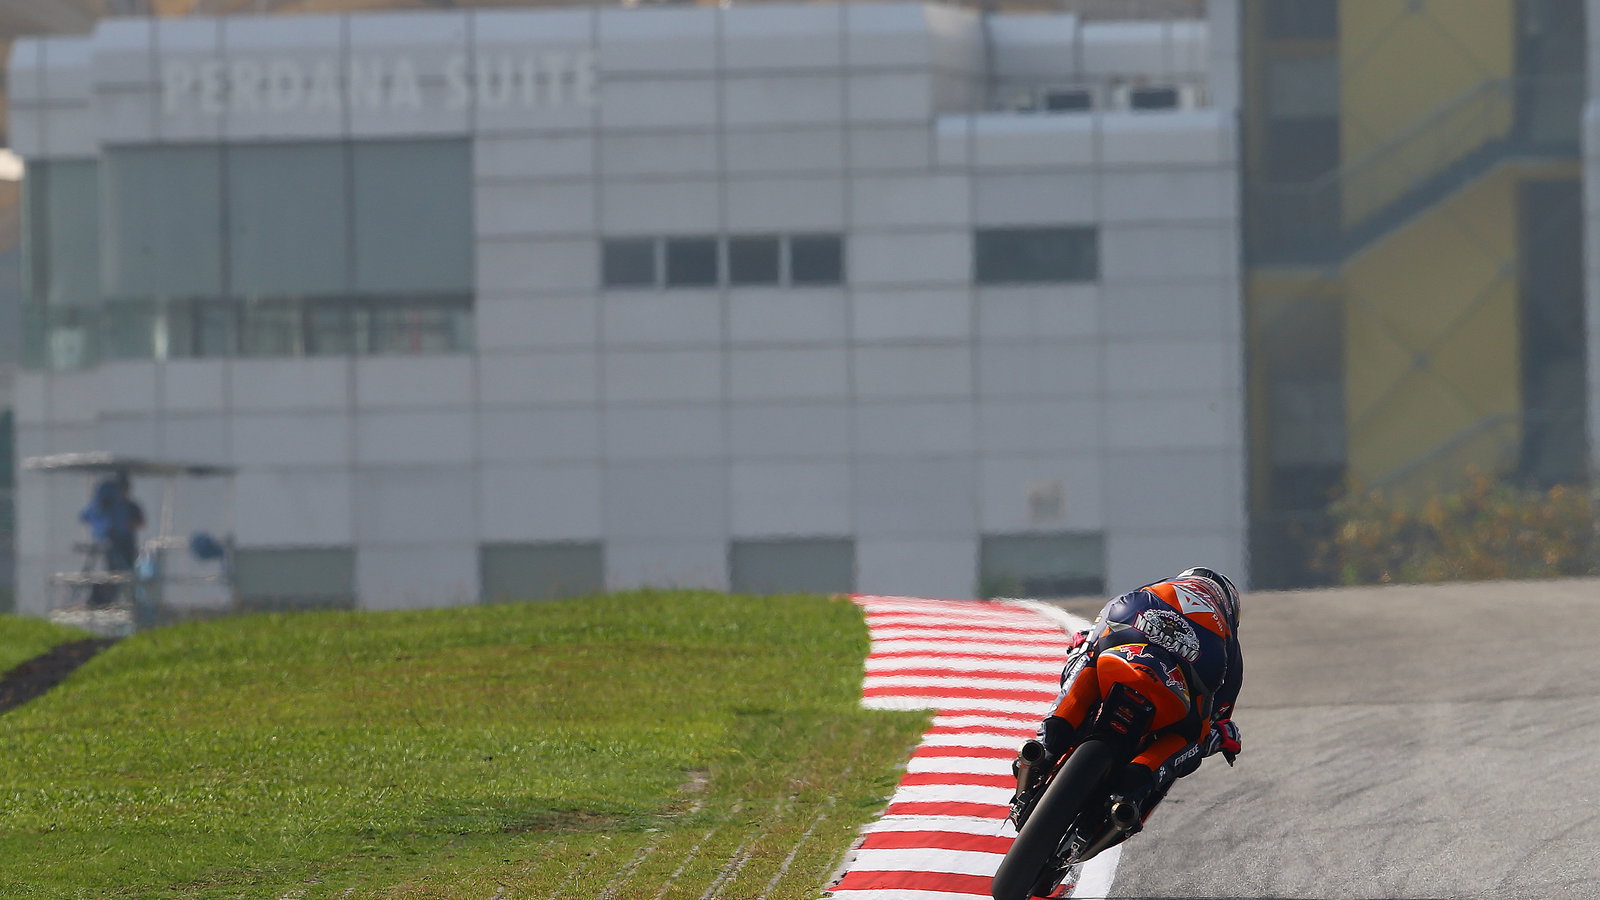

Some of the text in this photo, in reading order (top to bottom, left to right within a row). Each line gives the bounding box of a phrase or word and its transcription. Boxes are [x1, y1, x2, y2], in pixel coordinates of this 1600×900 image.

[163, 51, 599, 114] PERDANA SUITE
[1133, 612, 1201, 663] MEXICANO
